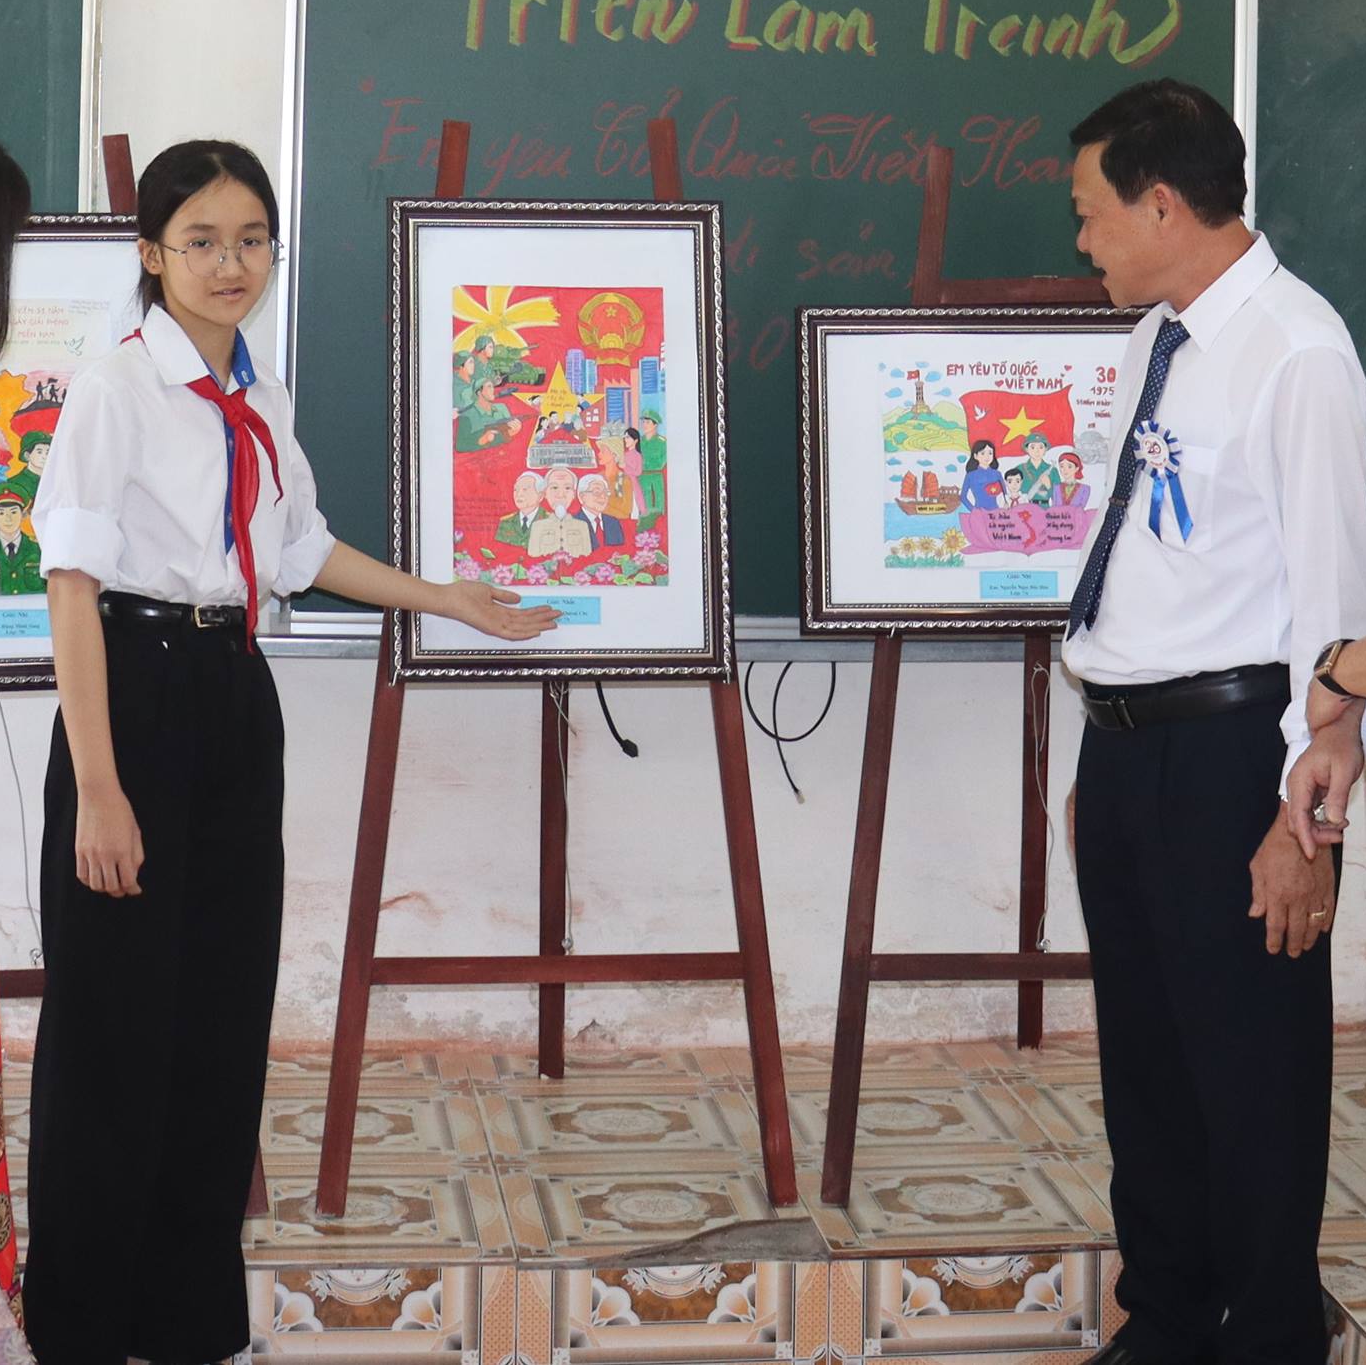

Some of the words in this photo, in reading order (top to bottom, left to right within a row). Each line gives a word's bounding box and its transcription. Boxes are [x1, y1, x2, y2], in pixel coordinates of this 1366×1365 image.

[946, 363, 964, 376] EM
[969, 361, 990, 376] YÊU
[1010, 360, 1039, 377] QUỐC
[1095, 366, 1117, 383] 30
[1037, 378, 1063, 389] NAM
[1090, 386, 1115, 396] 1975
